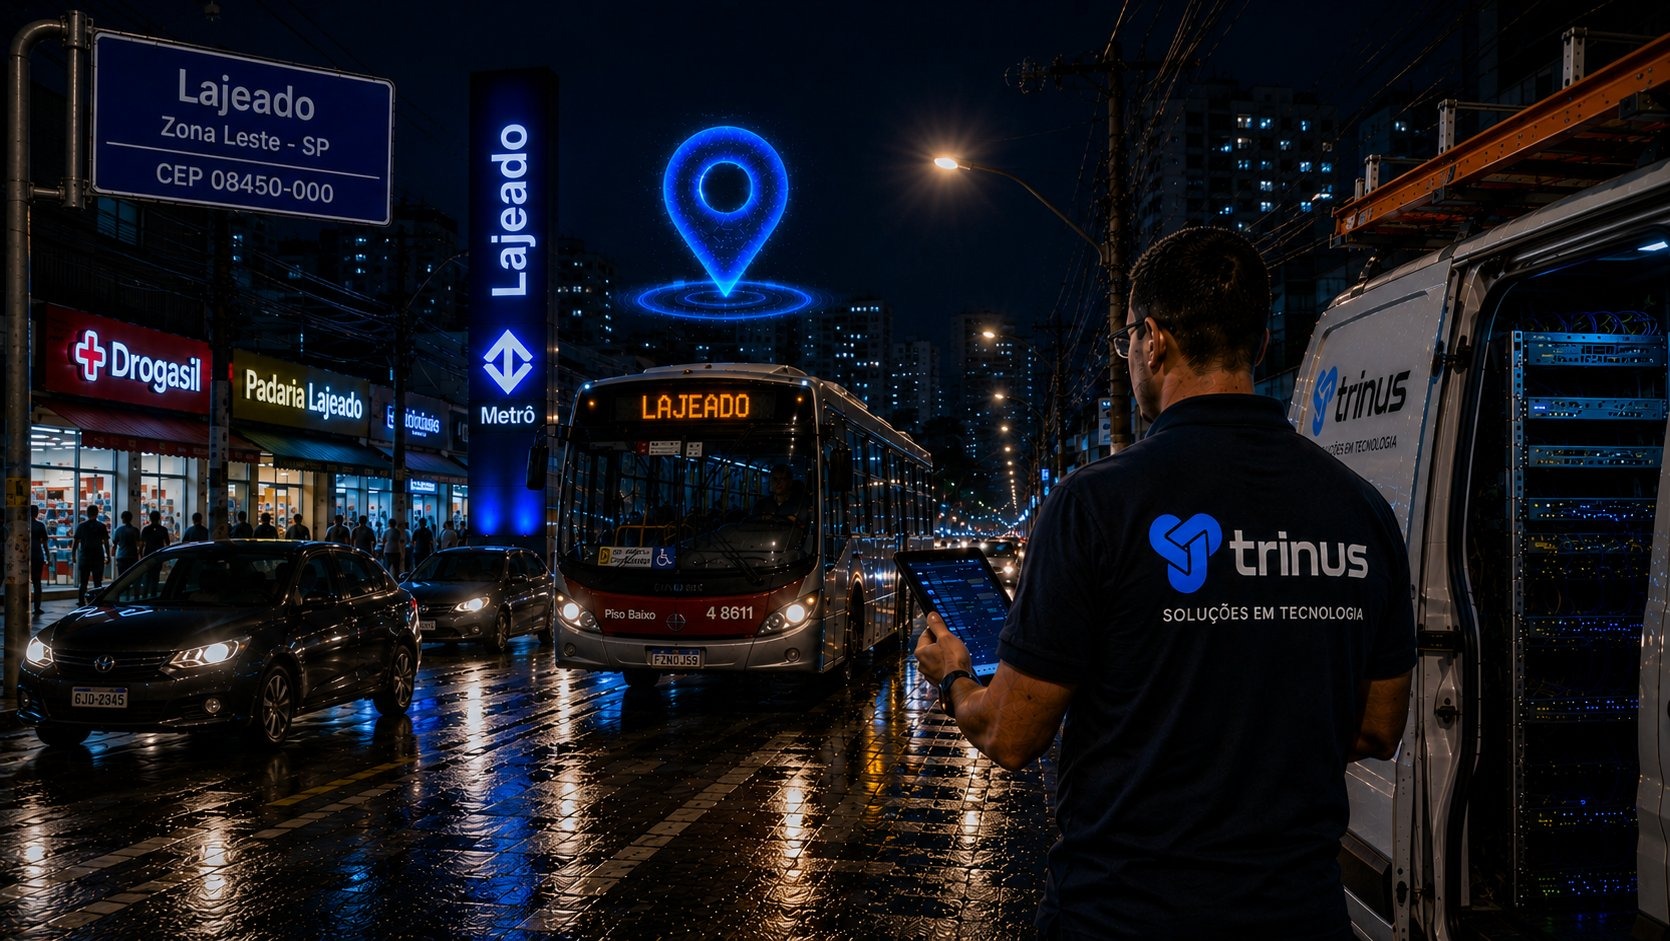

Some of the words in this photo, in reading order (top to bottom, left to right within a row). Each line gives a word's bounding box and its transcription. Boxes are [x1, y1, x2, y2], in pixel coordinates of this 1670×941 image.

[178, 68, 315, 121] Lajeado
[161, 116, 216, 143] Zona
[224, 125, 280, 151] Leste
[302, 136, 330, 157] SP
[156, 162, 203, 187] CEP
[210, 169, 334, 203] 08450-000
[491, 123, 536, 296] Lajeado
[111, 341, 201, 393] Drogasil
[246, 369, 305, 410] Padaria
[308, 383, 363, 420] Lajeado
[480, 405, 536, 425] Metrô
[642, 393, 750, 420] LAJEADO
[1335, 370, 1411, 423] trinus
[1355, 435, 1397, 453] TECNOLOGIA
[1229, 530, 1369, 579] trinus
[604, 608, 626, 619] Piso
[628, 609, 656, 620] Baixo
[706, 606, 716, 620] 4
[720, 606, 753, 620] 8611
[1162, 603, 1249, 625] SOLUÇÕES
[1253, 606, 1275, 620] EM
[1279, 606, 1364, 621] TECNOLOGIA
